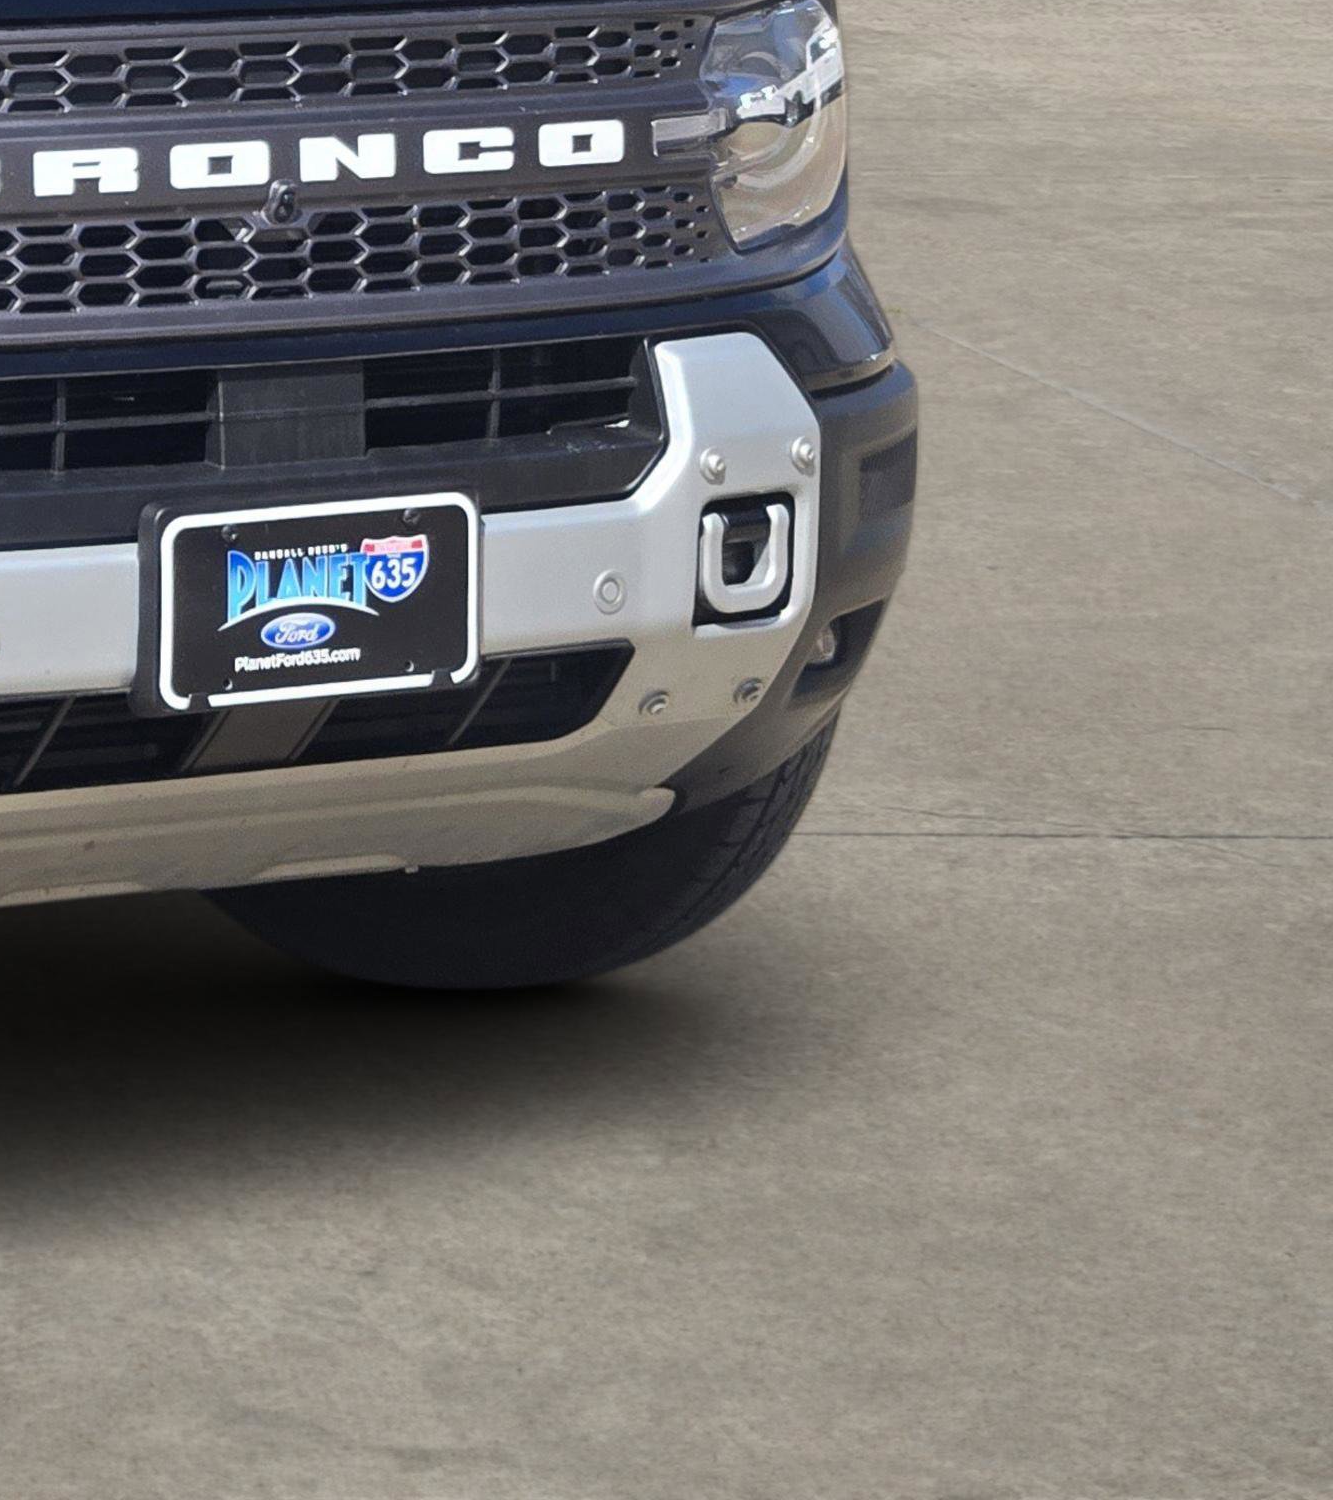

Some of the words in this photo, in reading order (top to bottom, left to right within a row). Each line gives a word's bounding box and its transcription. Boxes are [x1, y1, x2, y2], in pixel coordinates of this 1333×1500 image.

[228, 550, 370, 621] PLANET
[372, 557, 416, 589] 635
[275, 618, 318, 644] Ford
[234, 648, 361, 672] PlanetFord635.com
